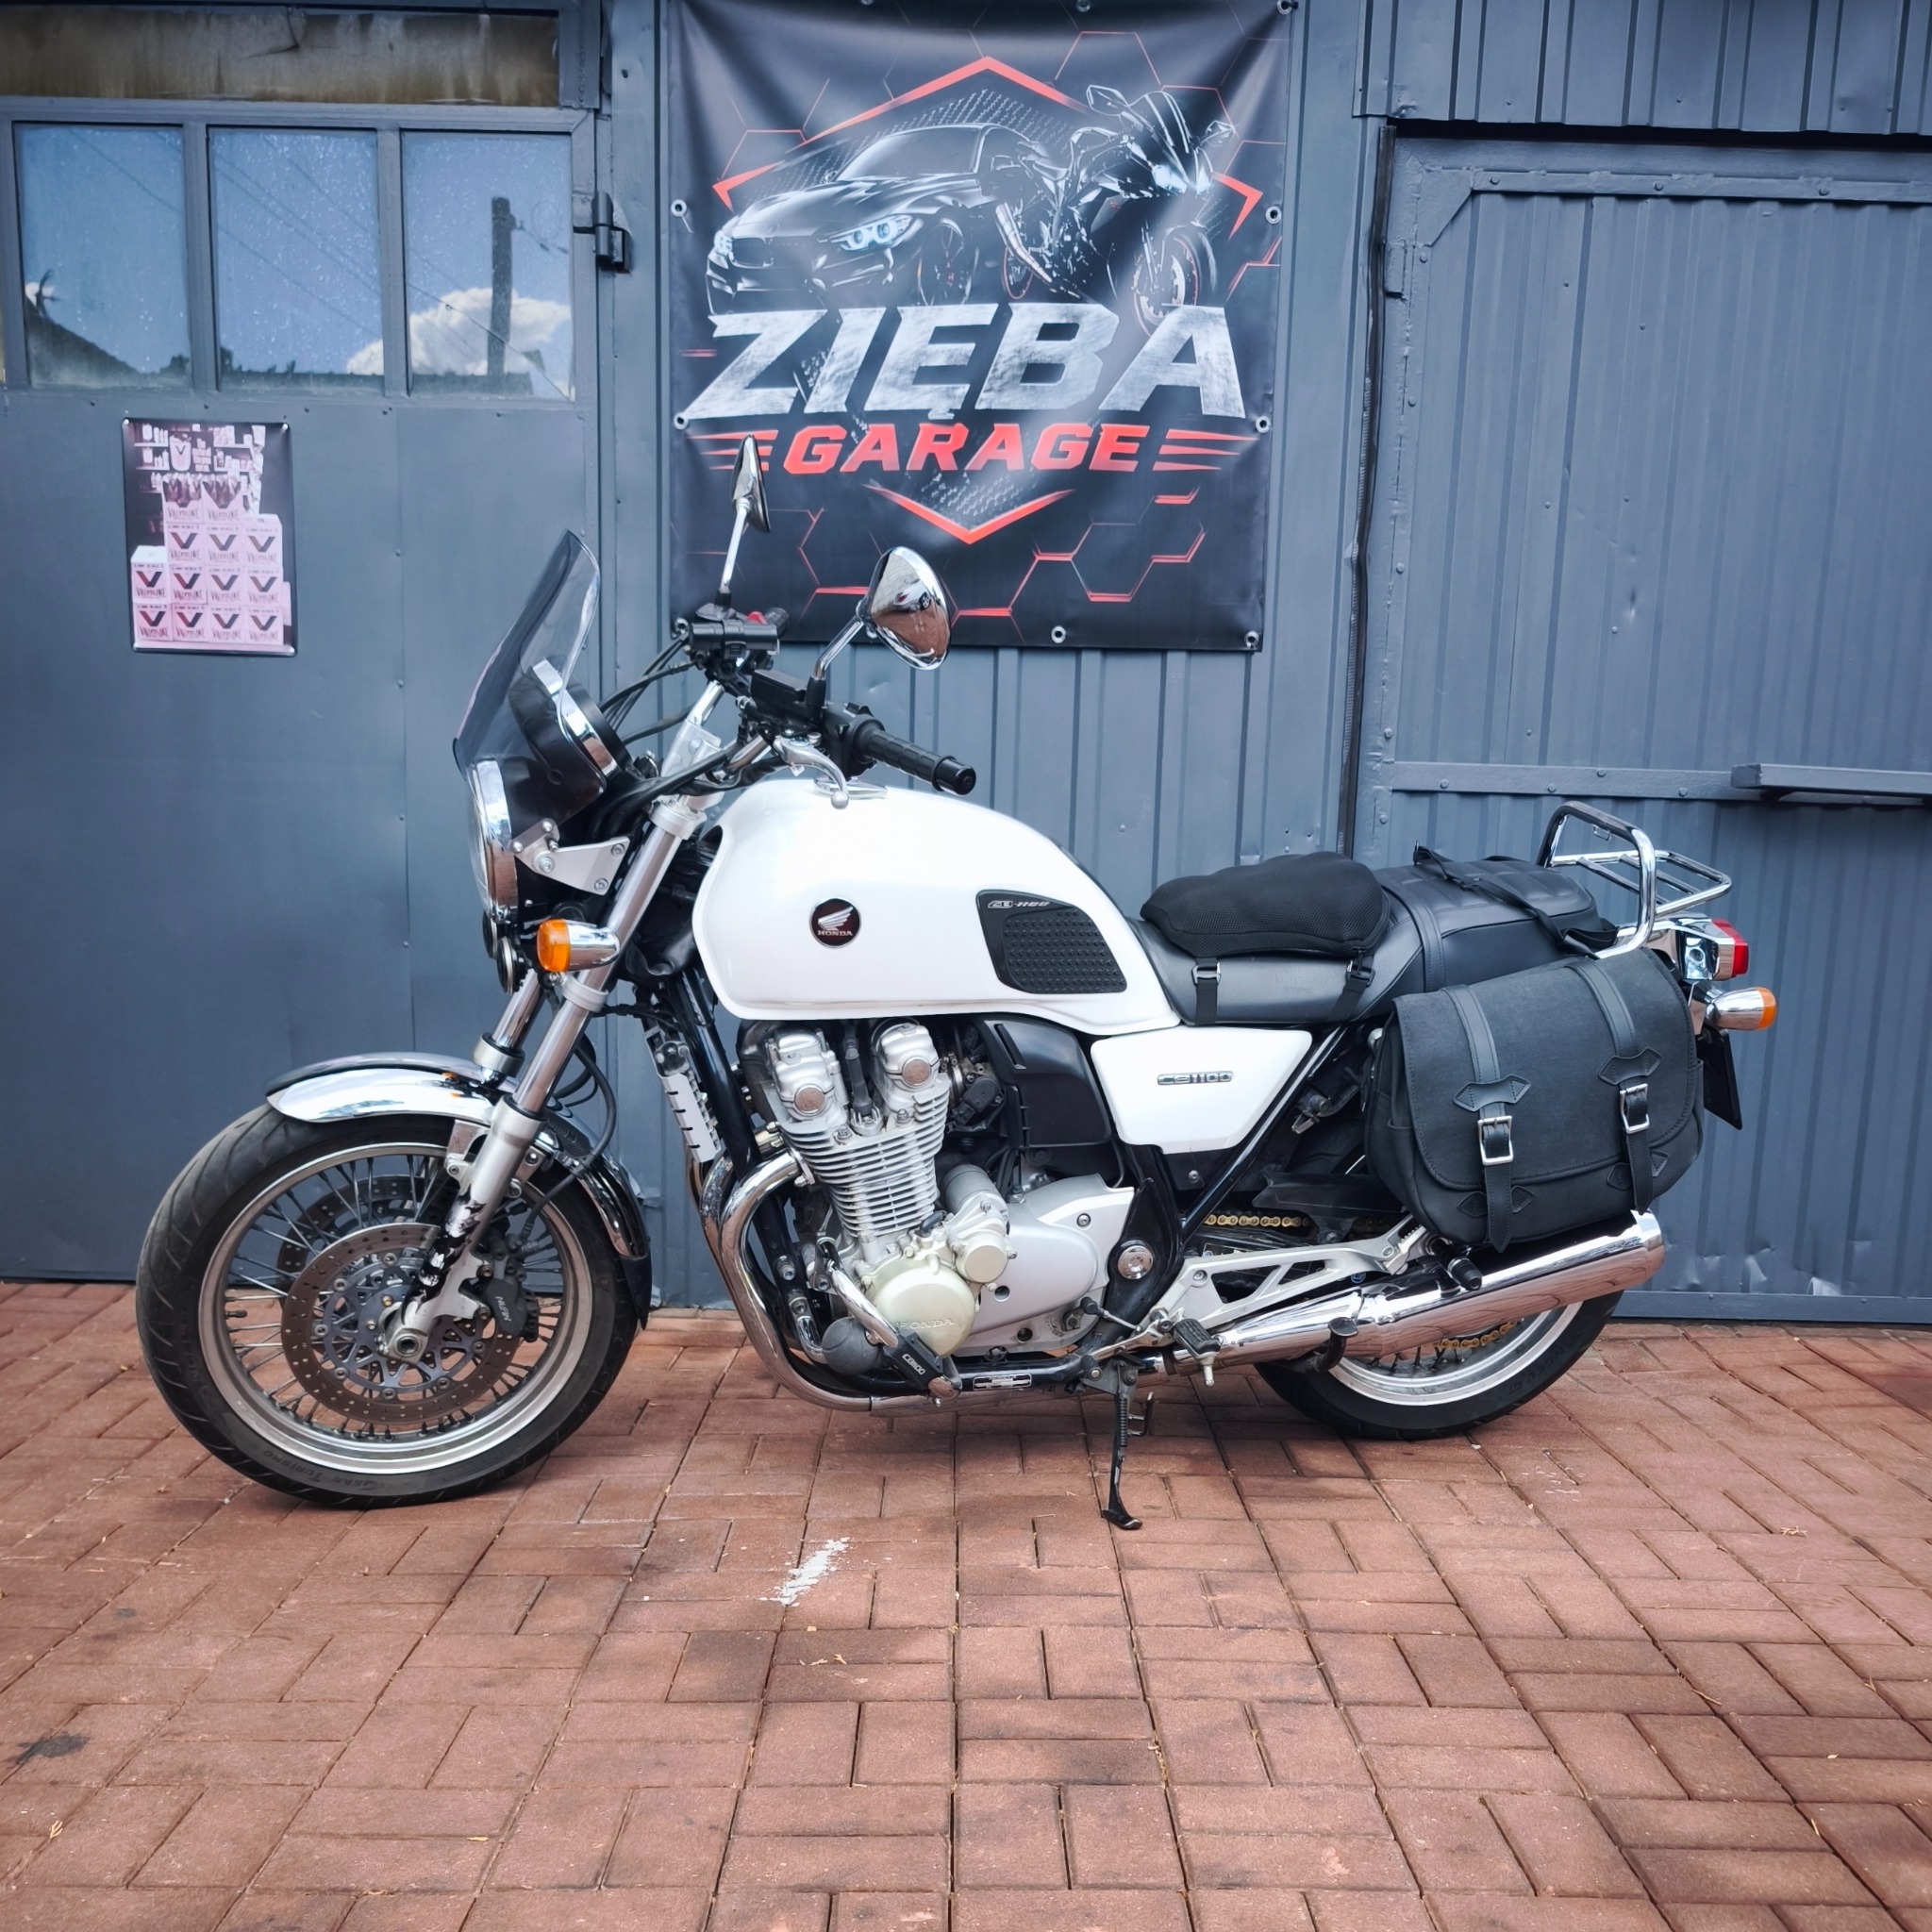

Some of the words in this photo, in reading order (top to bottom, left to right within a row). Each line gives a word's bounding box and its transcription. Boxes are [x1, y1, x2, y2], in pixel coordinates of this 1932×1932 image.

[683, 303, 1246, 420] ZIĘBA
[783, 424, 1150, 475] GARAGE
[896, 1318, 956, 1330] HONDA
